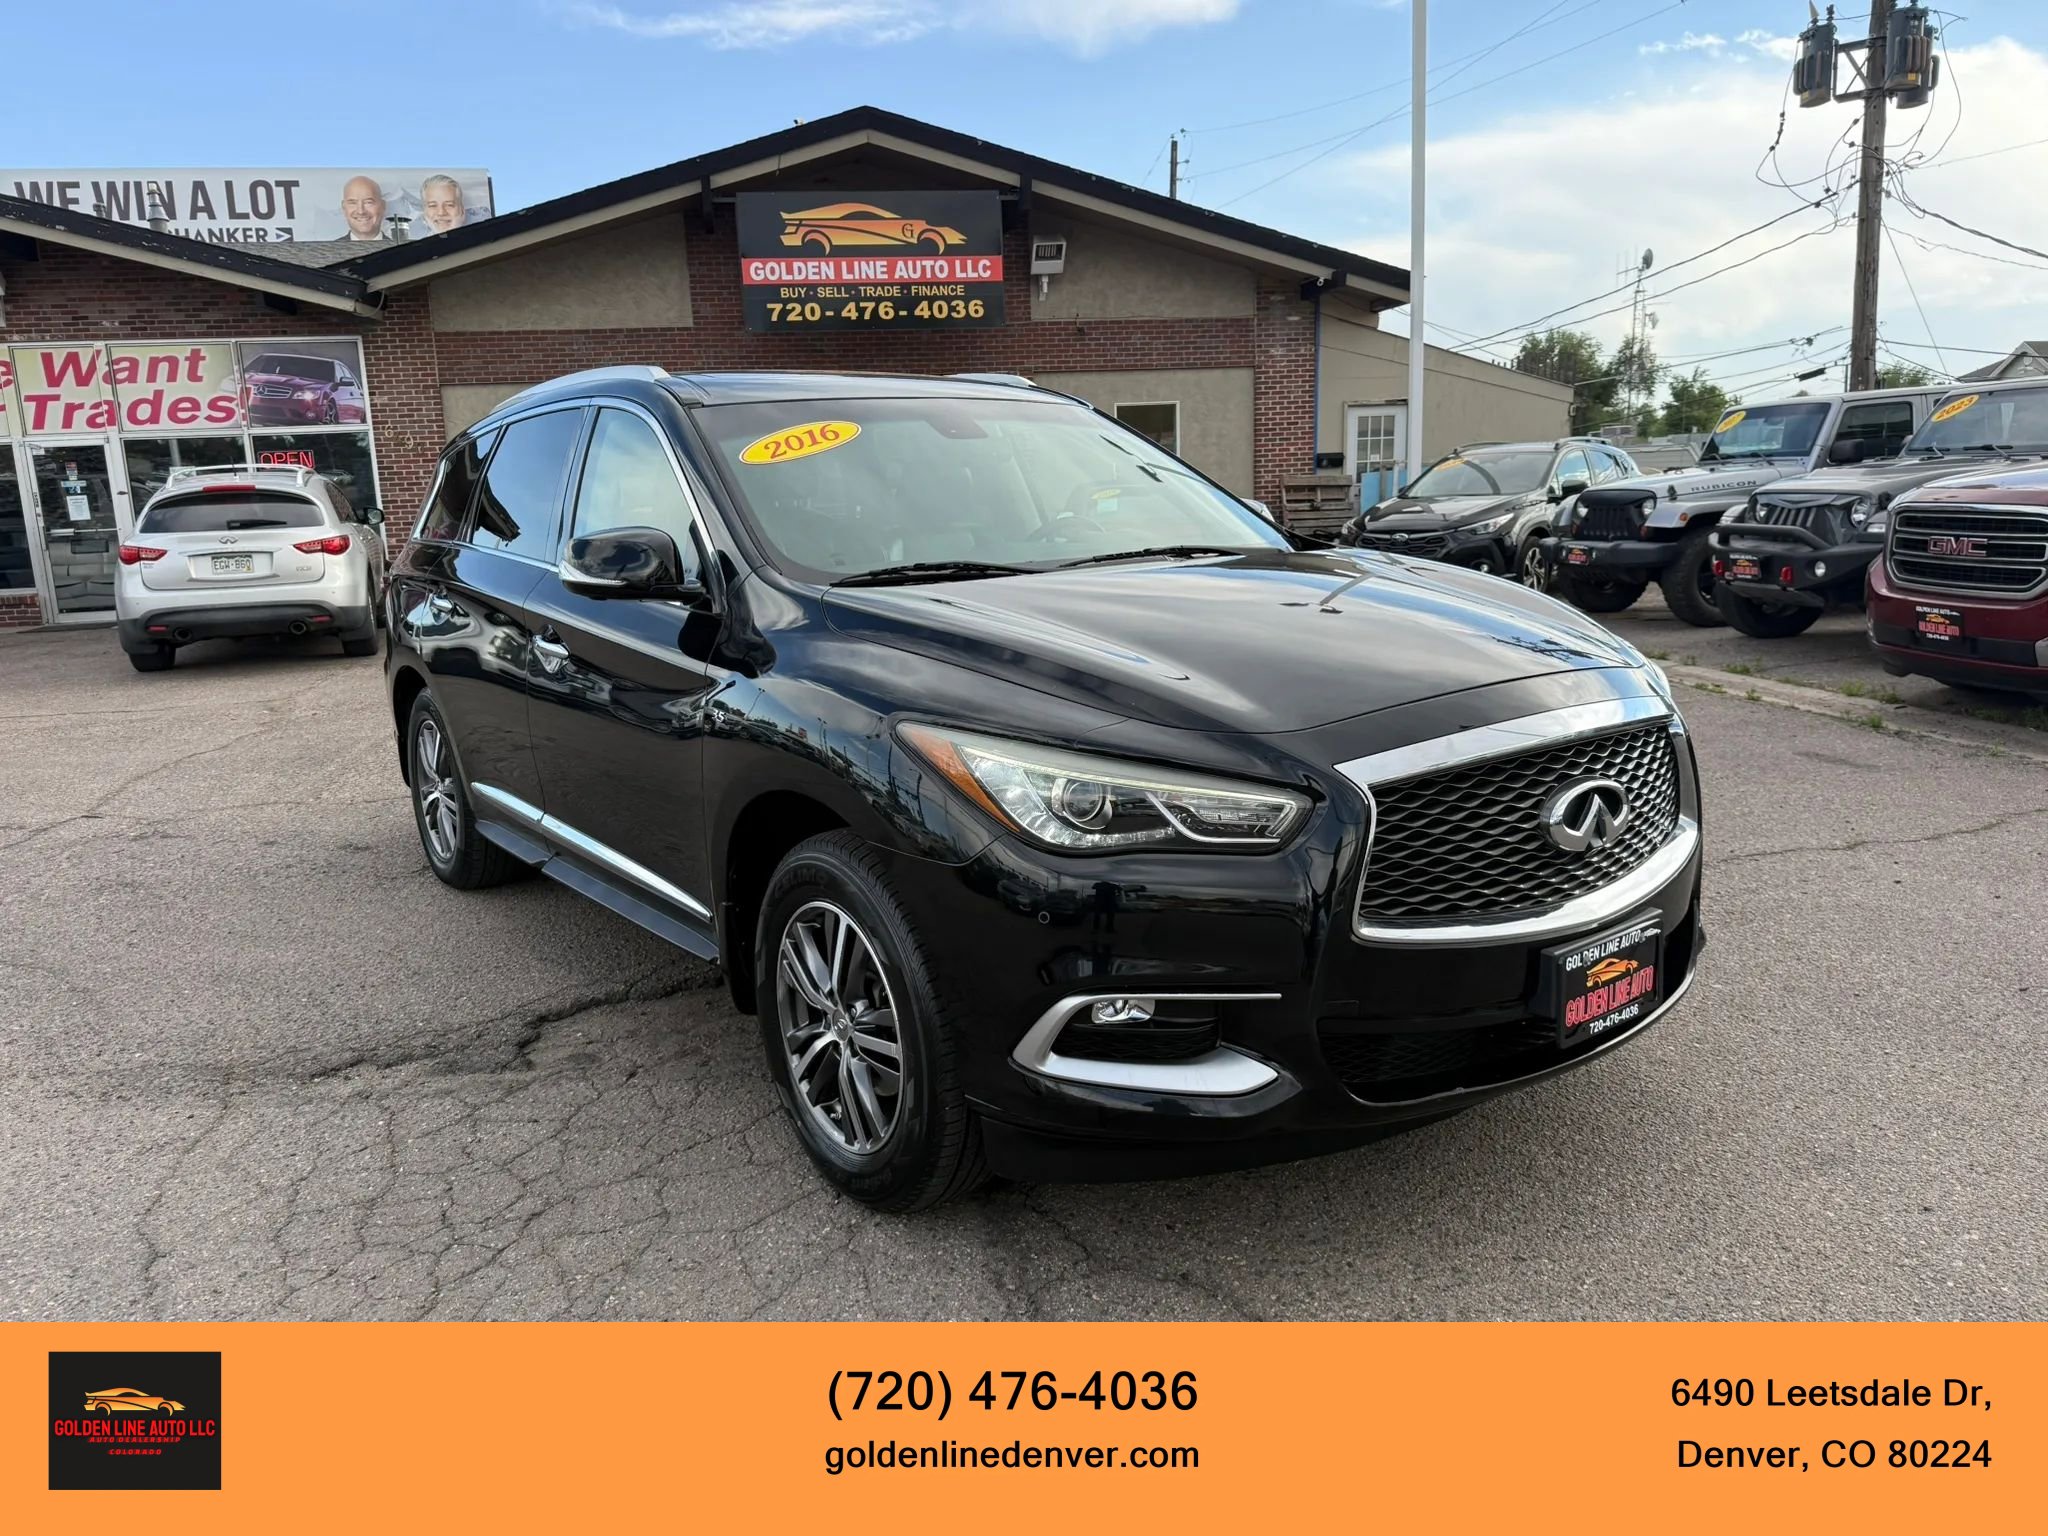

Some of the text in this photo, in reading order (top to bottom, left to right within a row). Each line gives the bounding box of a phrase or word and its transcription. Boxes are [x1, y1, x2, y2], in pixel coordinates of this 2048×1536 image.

[14, 179, 300, 221] WE WIN A LOT
[749, 258, 991, 281] GOLDEN LINE AUTO LLC
[780, 284, 965, 298] BUY SELL TRADE FINANCE
[40, 347, 207, 388] Want
[23, 385, 252, 431] Trades!
[764, 423, 840, 459] 2016
[260, 451, 313, 469] OPEN
[1691, 480, 1757, 492] RUBICON
[1928, 535, 1988, 557] GMC
[1565, 929, 1642, 971] GOLDEN LINE AUTO
[1565, 965, 1654, 1027] GOLDEN LINE AUTO
[1589, 1003, 1639, 1034] 720-476-4036
